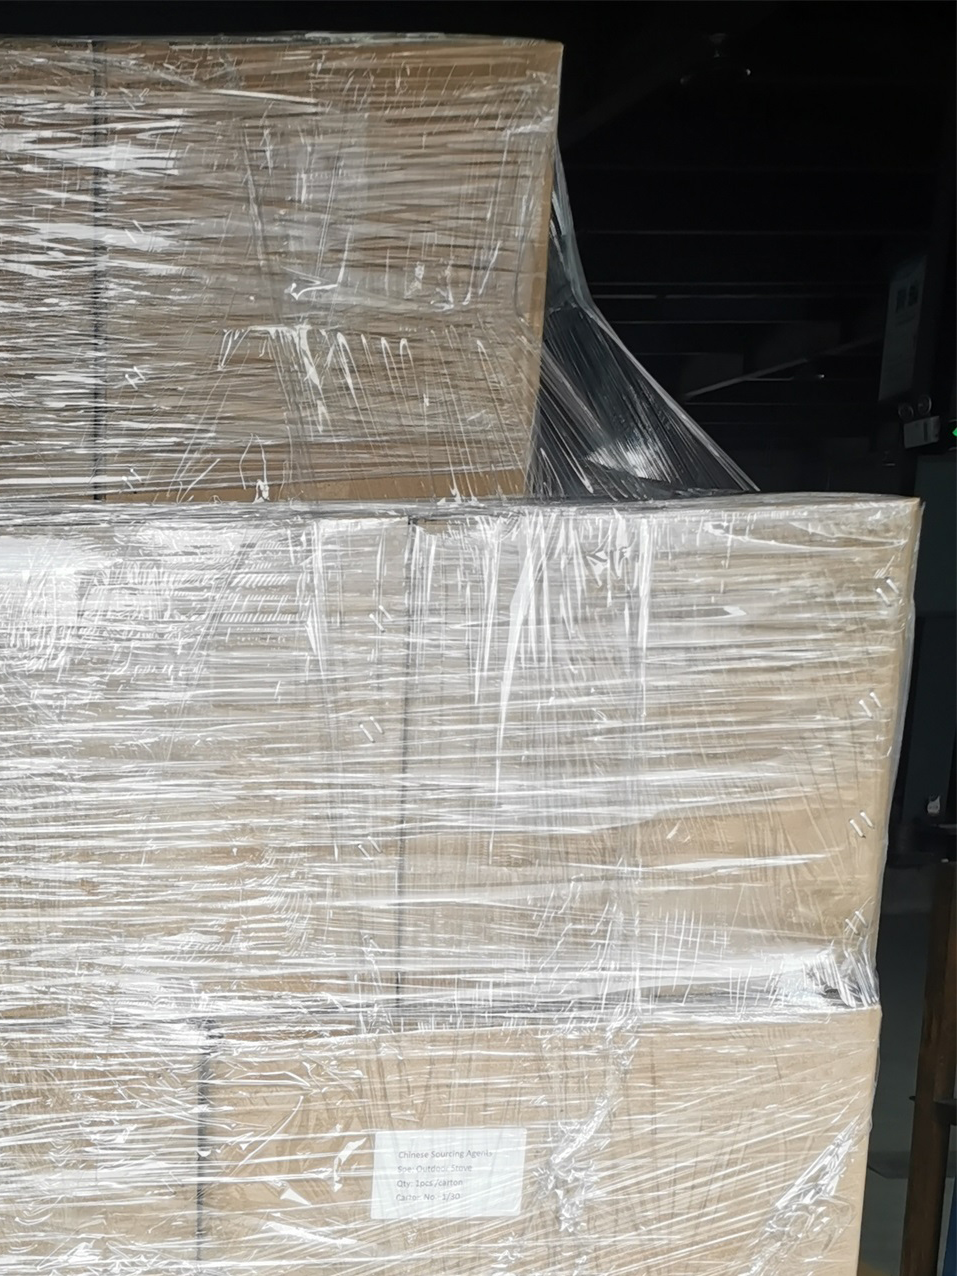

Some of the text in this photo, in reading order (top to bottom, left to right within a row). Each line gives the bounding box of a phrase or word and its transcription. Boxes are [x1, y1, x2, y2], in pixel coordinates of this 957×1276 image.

[398, 1150, 493, 1159] Chinese Sourcing Agents
[451, 1163, 472, 1173] Stove
[397, 1180, 413, 1189] Qty:
